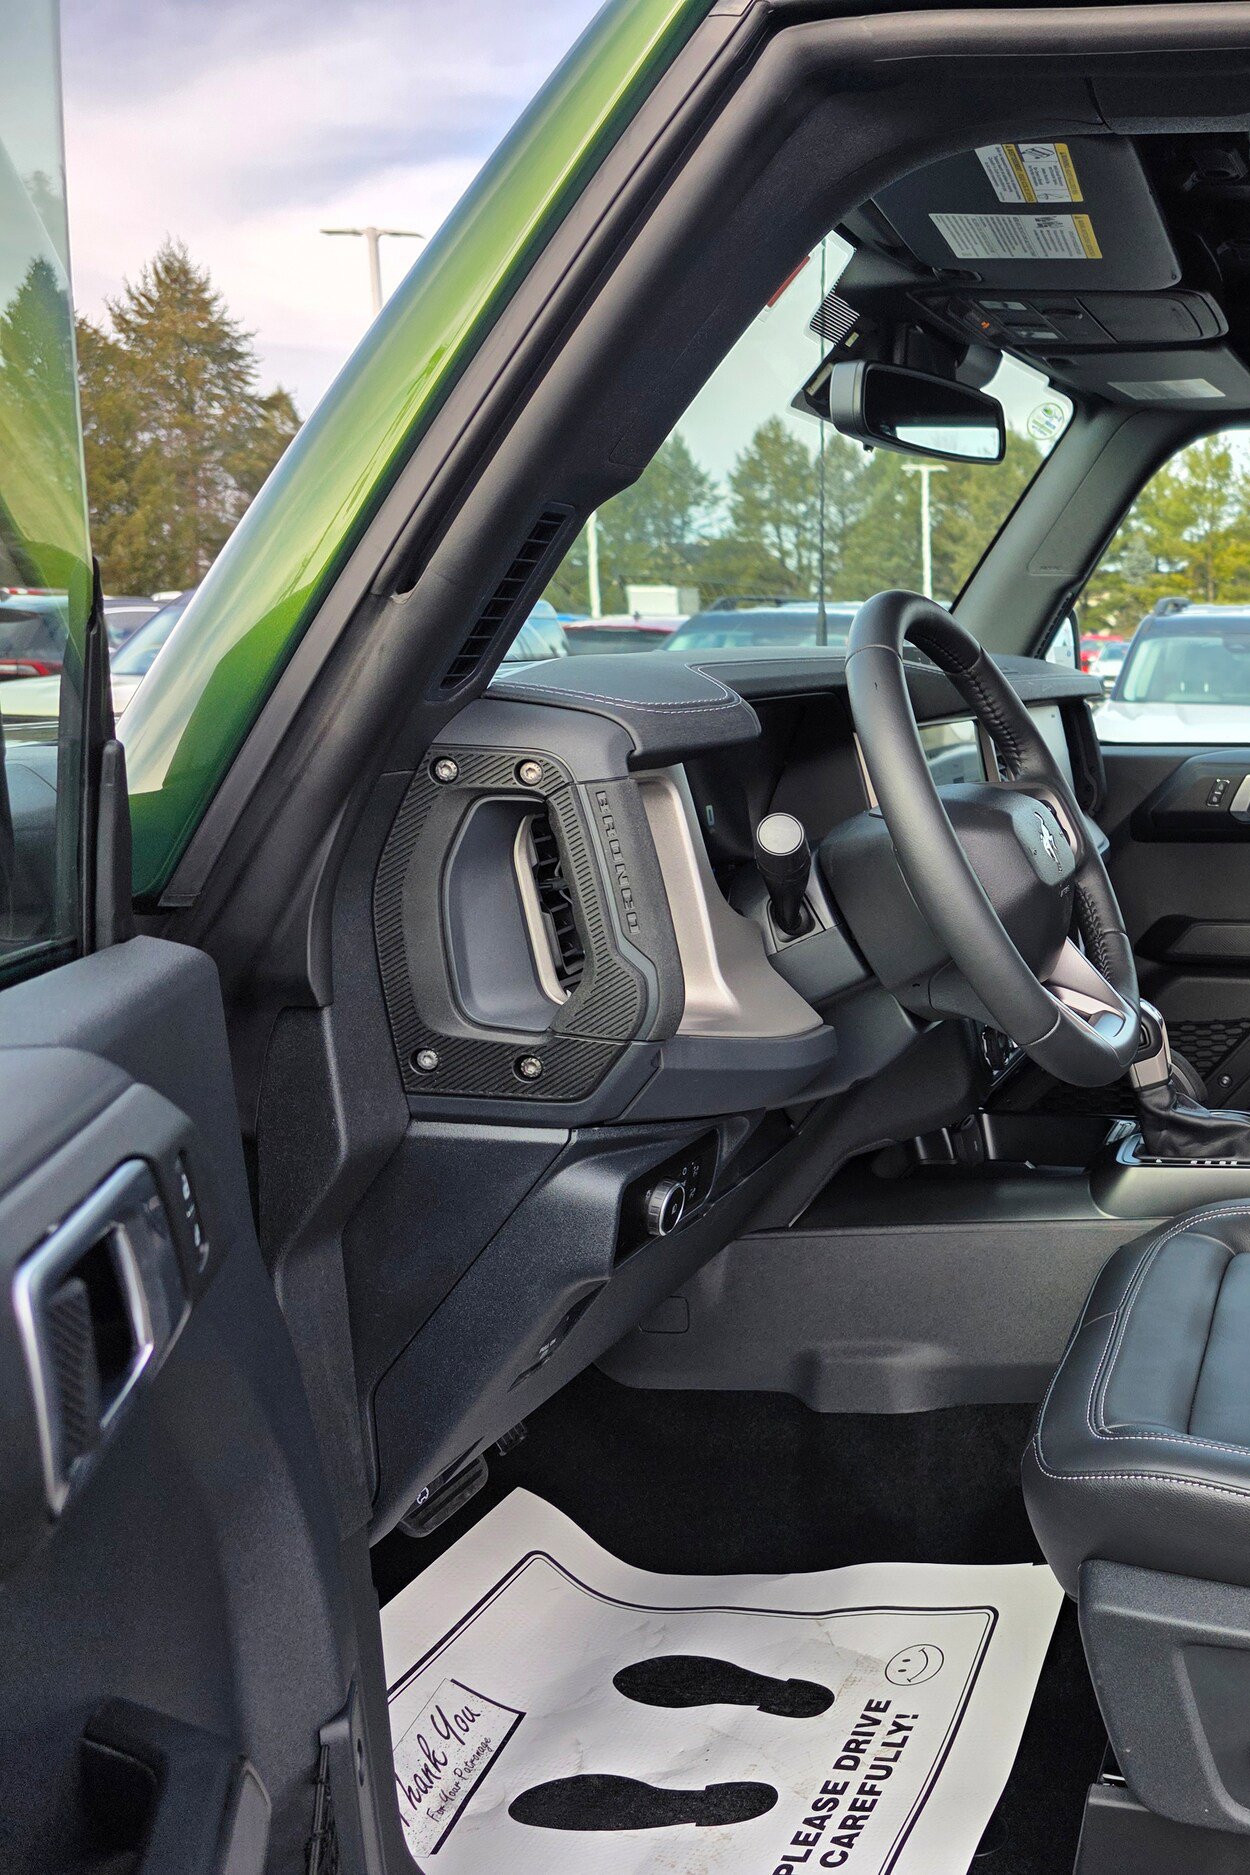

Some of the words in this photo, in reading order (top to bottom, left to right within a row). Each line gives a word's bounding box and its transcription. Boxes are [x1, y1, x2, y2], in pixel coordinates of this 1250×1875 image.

[595, 790, 641, 935] BRONCO
[395, 1733, 449, 1827] hank
[430, 1704, 481, 1746] You
[426, 1805, 446, 1823] For
[453, 1736, 493, 1783] Patronage
[772, 1780, 850, 1875] PLEASE
[832, 1699, 892, 1771] DRIVE
[819, 1714, 919, 1868] CAREFULLY!
